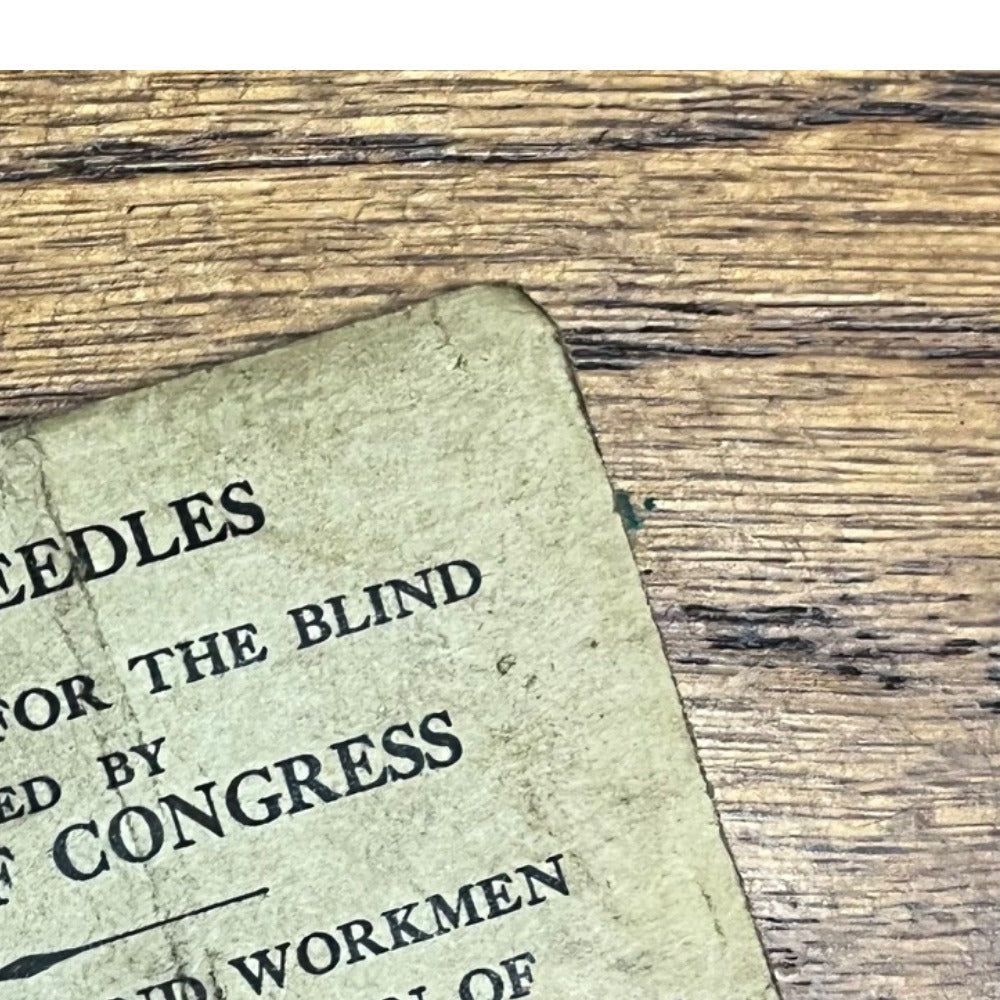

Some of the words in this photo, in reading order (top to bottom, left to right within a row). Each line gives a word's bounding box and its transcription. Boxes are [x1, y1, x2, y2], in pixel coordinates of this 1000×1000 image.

[127, 621, 270, 697] THE
[287, 557, 483, 649] BLIND
[52, 711, 465, 883] CONGRESS
[97, 737, 166, 791] BY
[230, 853, 573, 999] WORKMEN
